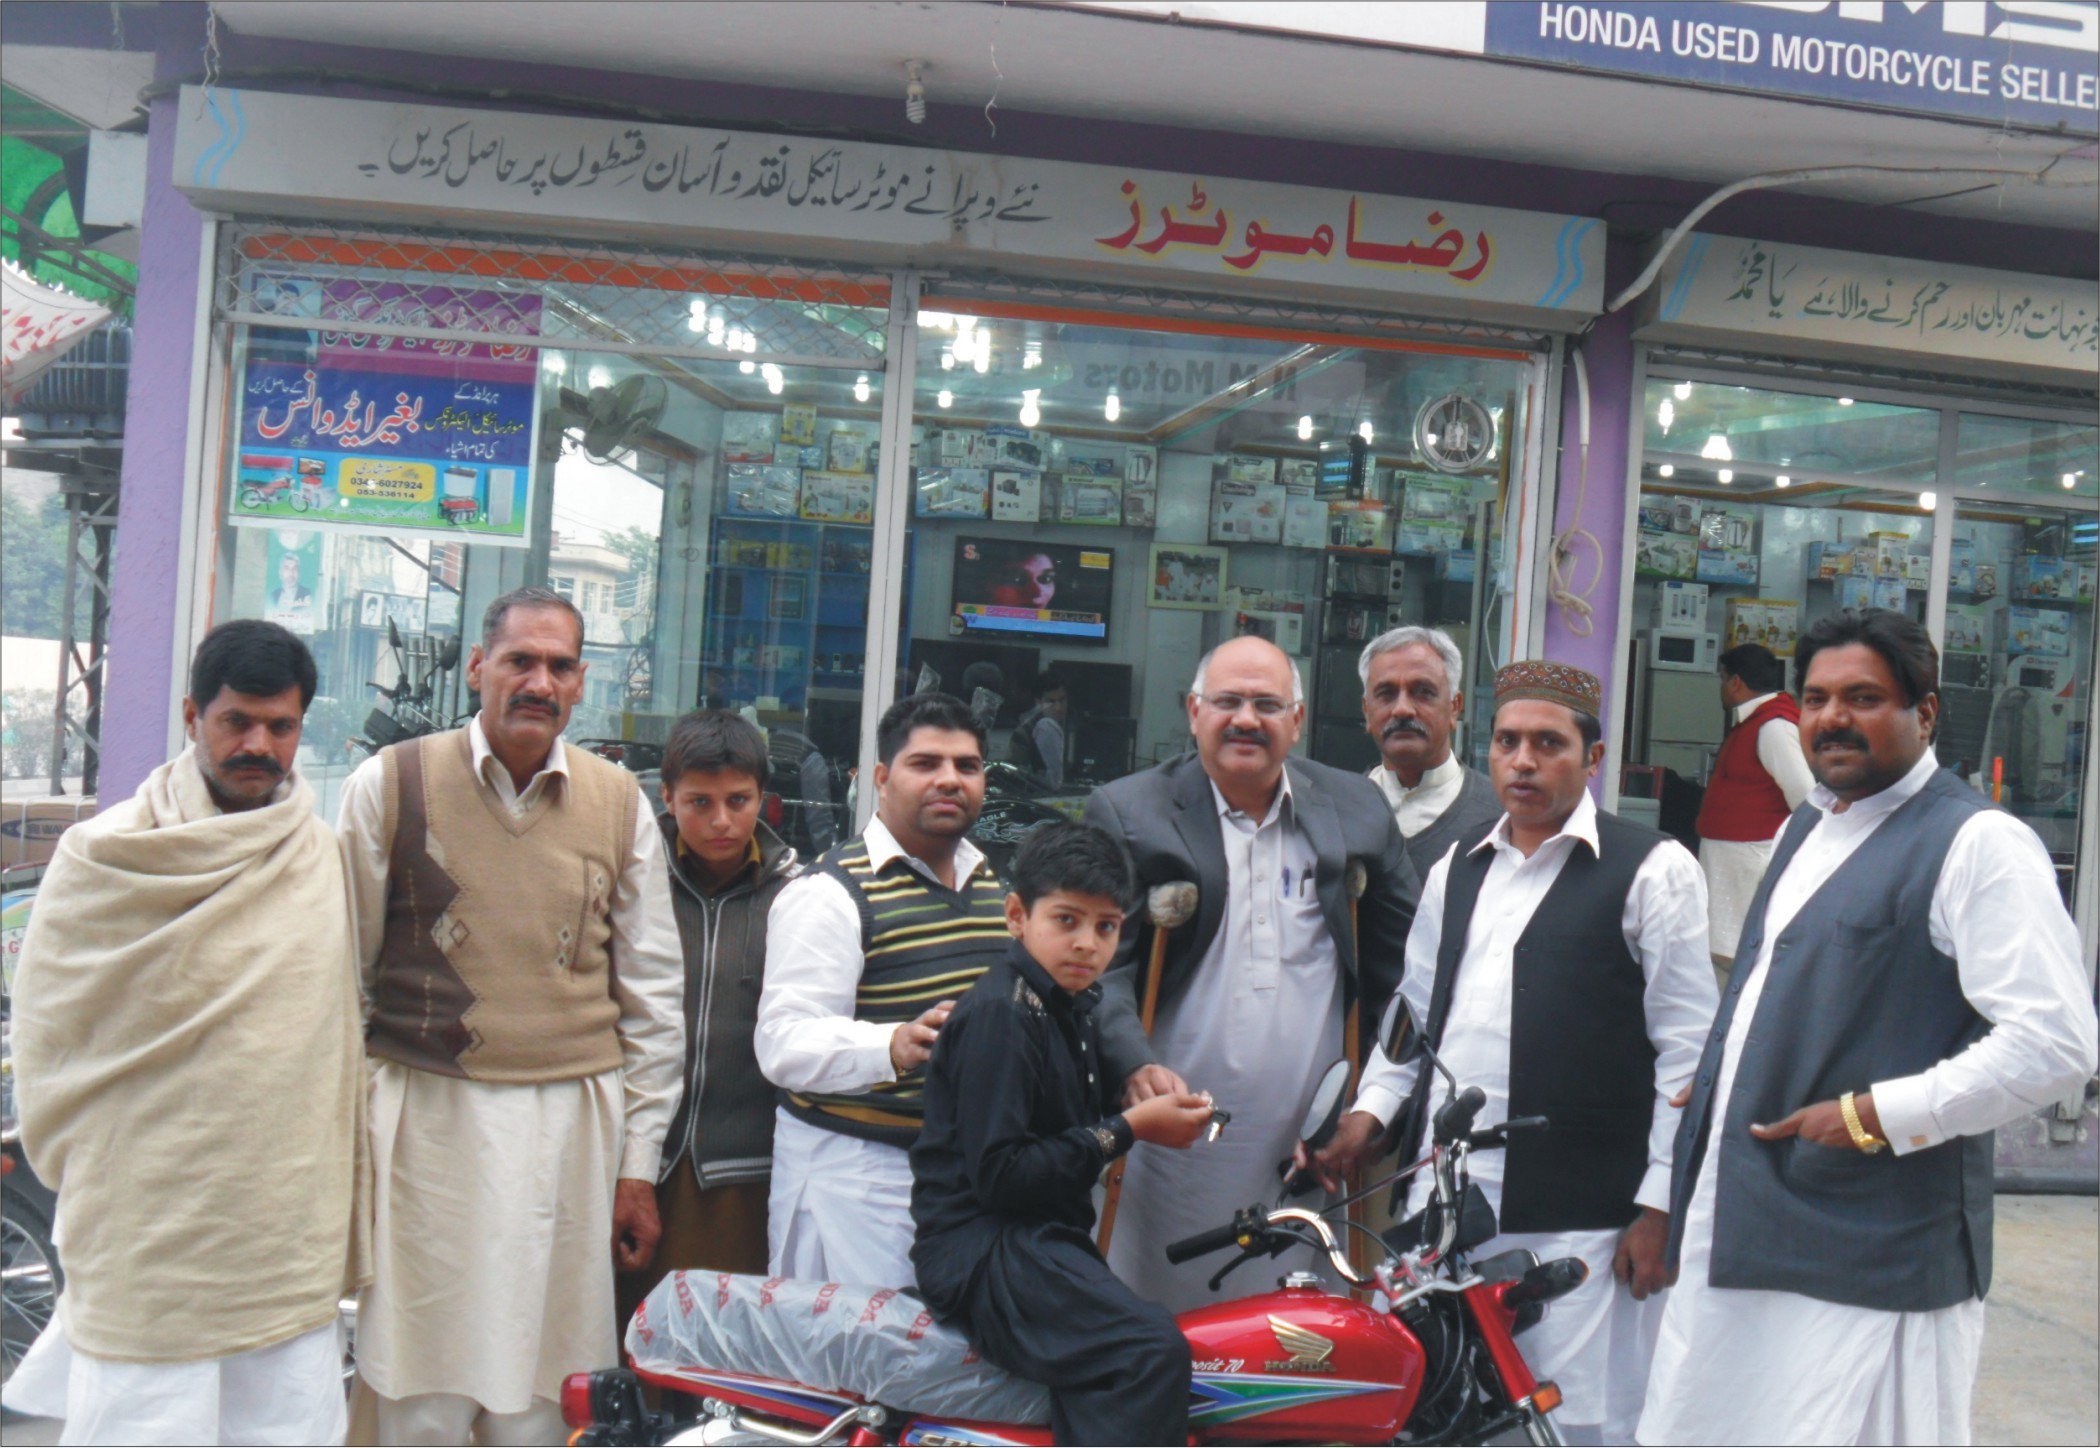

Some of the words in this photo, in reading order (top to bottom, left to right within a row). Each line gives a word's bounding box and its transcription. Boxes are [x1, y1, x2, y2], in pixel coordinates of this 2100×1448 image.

[1540, 2, 1661, 53] HONDA
[1671, 20, 1760, 64] USED
[1771, 33, 1990, 96] MOTORCYCLE
[2000, 64, 2099, 110] SELLE
[642, 135, 731, 194] آسان
[1093, 178, 1336, 273] موٹرز
[1345, 194, 1493, 284] رضا
[257, 369, 376, 447] ایڈوانس
[358, 392, 424, 446] بغیر
[350, 477, 424, 490] 034-6027924
[1224, 1358, 1245, 1373] 70
